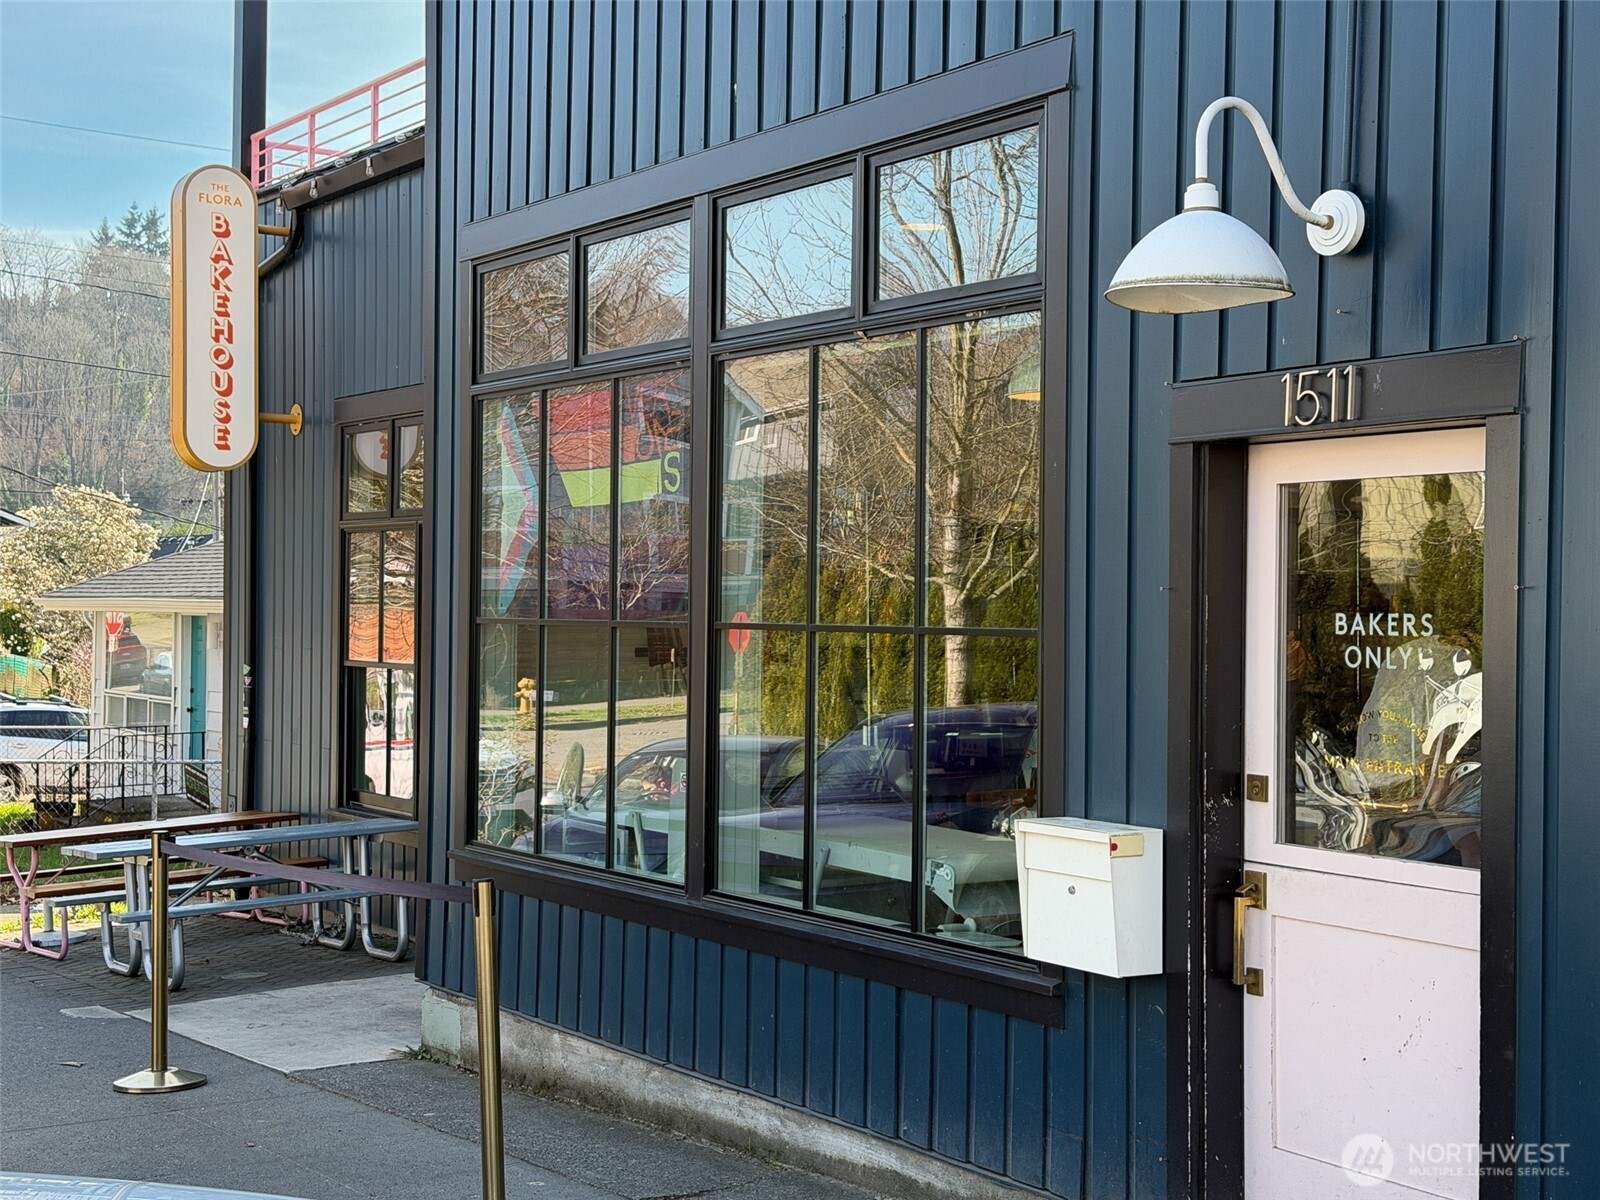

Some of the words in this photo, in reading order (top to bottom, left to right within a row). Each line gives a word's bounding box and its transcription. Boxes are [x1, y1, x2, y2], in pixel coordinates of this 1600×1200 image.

[198, 192, 243, 207] FLORA
[211, 183, 230, 192] THE
[209, 211, 234, 451] BAKEHOUSE
[1280, 365, 1356, 427] 1511
[1335, 612, 1434, 637] BAKERS
[1368, 733, 1380, 743] TO
[1324, 755, 1360, 771] MAIN
[1366, 758, 1447, 779] ENTRANE
